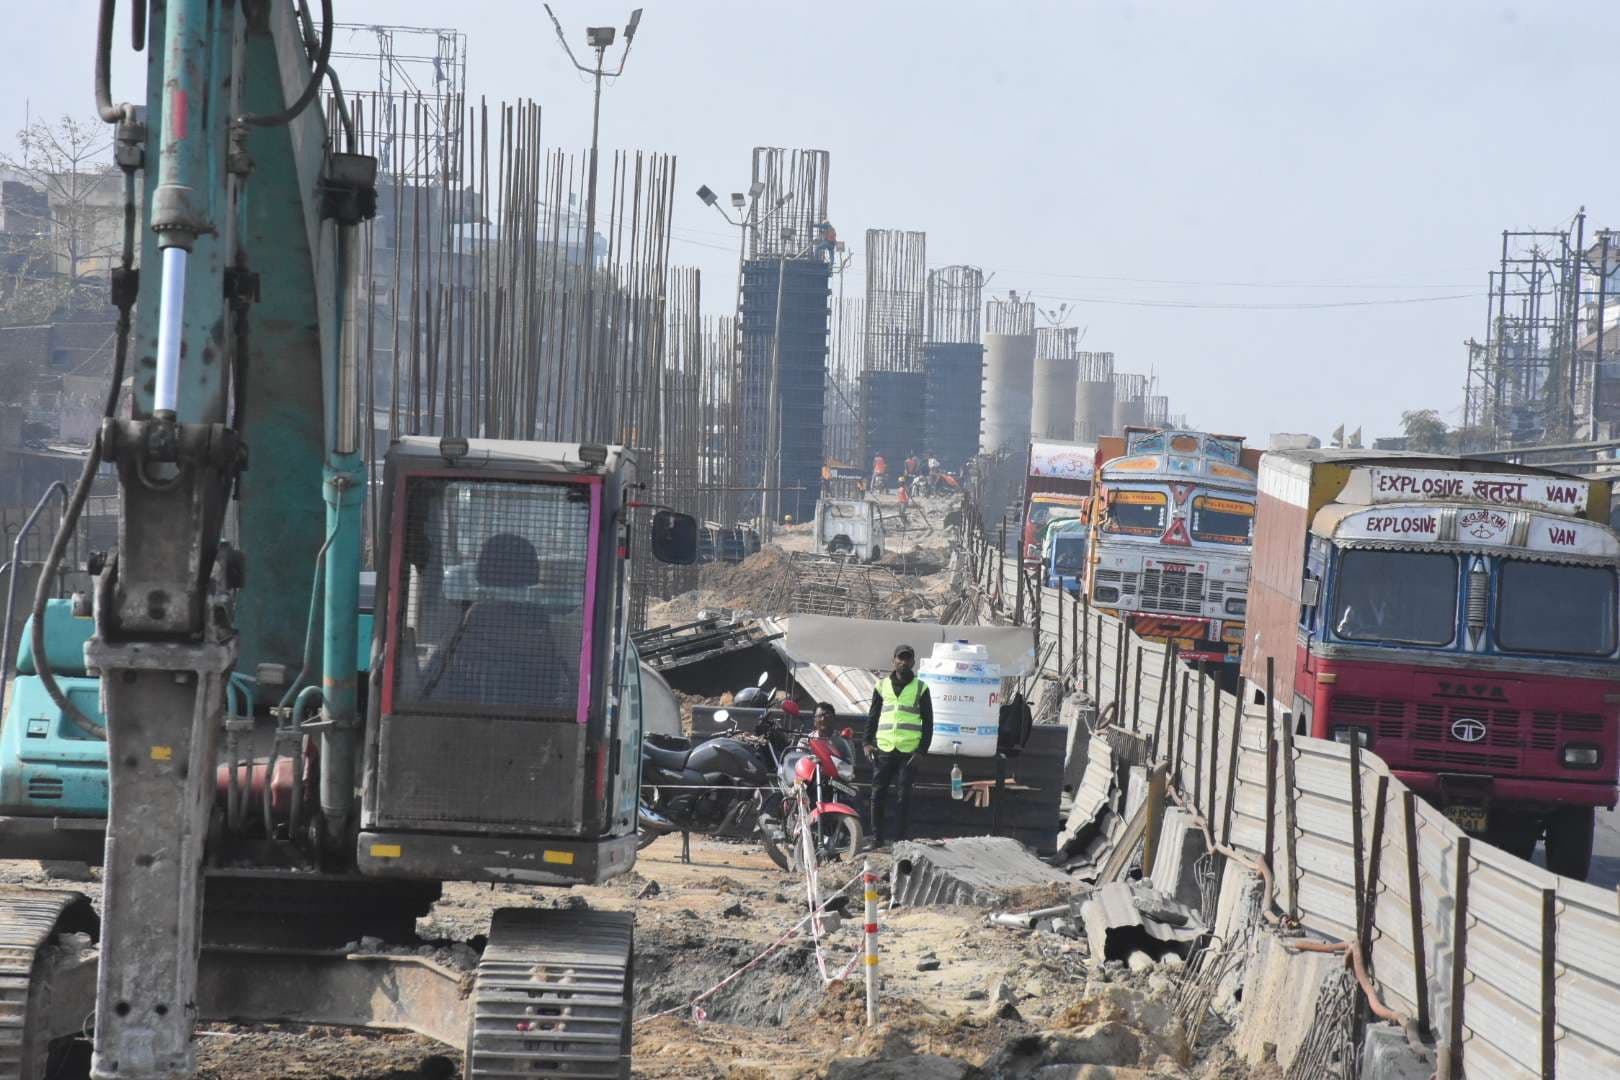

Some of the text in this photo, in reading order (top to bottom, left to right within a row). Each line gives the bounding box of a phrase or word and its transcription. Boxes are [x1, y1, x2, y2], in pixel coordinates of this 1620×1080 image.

[1380, 475, 1577, 503] EXPLOSIVE खतरा VAN
[1366, 515, 1436, 533] EXPLOSIVE
[1549, 527, 1576, 545] VAN
[1438, 682, 1505, 697] TATA
